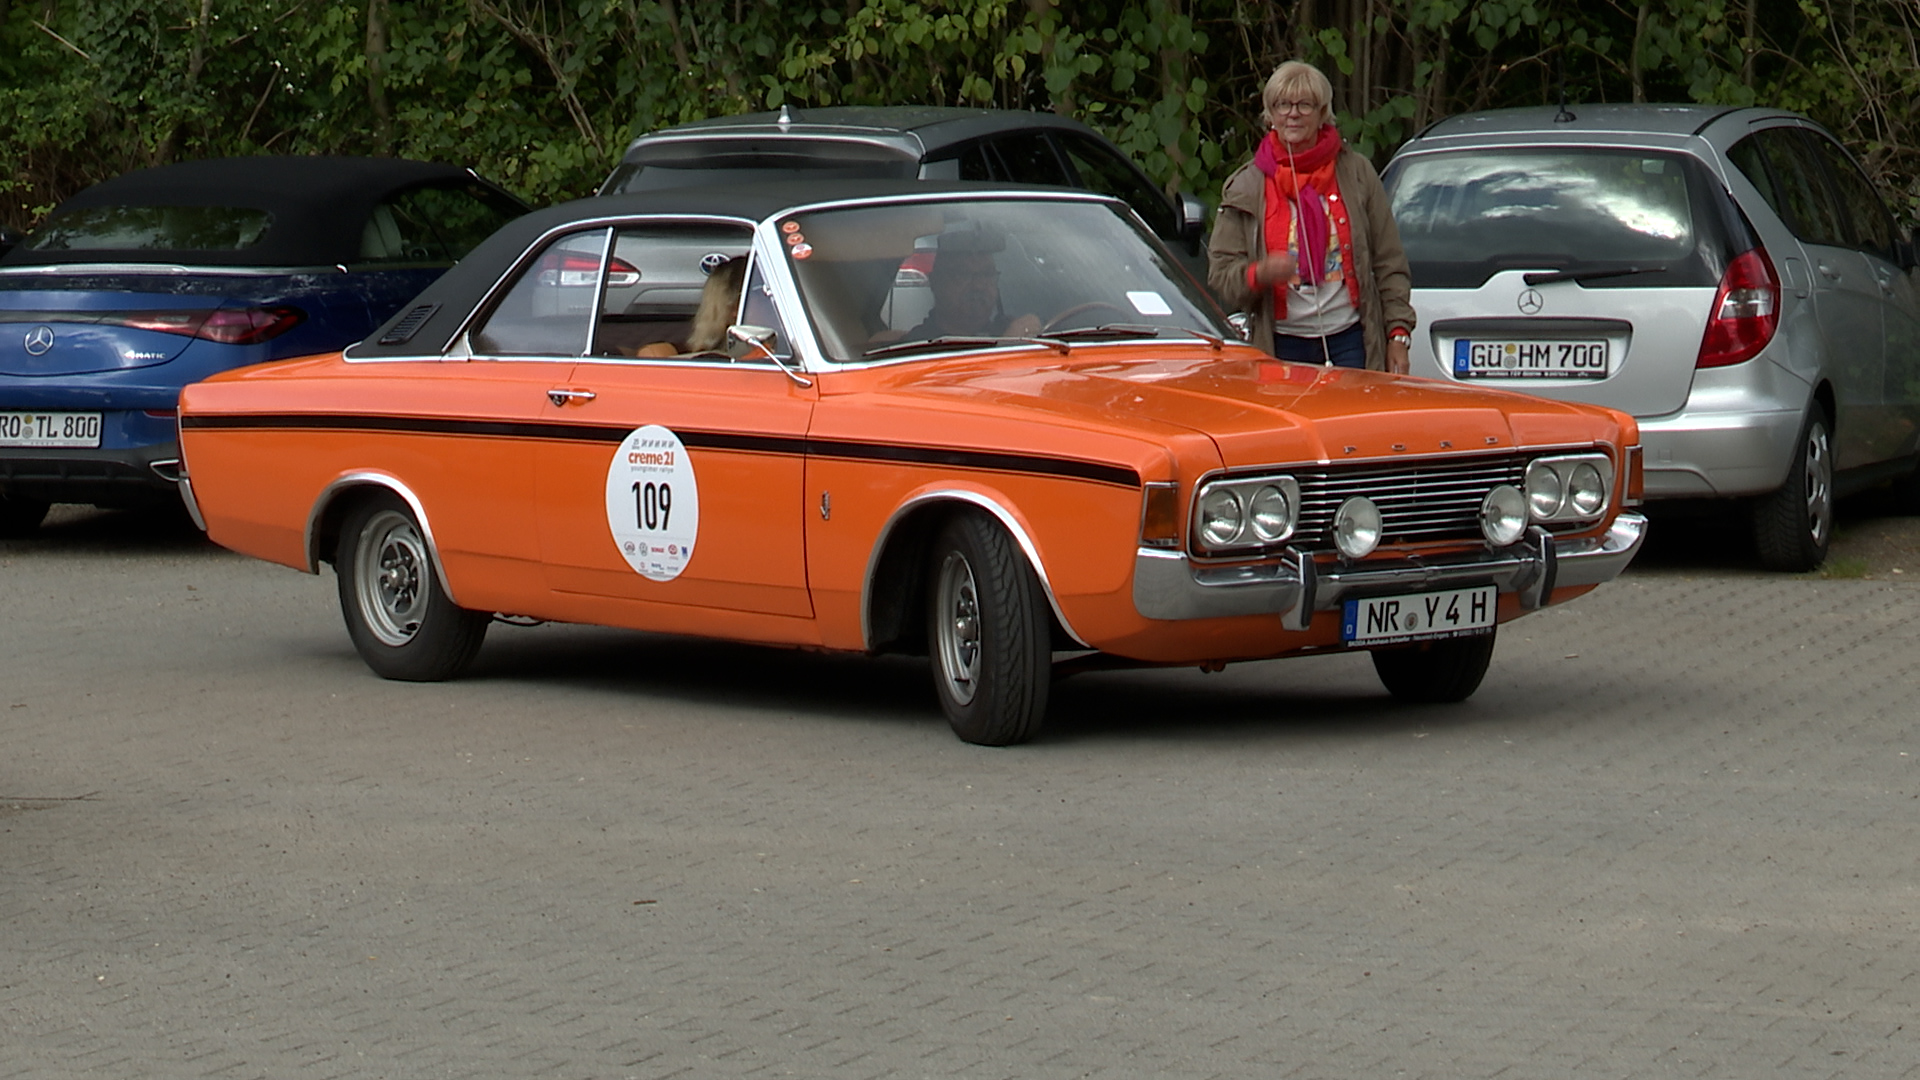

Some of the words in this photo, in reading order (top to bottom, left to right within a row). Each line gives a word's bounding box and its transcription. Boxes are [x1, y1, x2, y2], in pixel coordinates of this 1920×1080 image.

[1471, 344, 1502, 367] GÜ
[1518, 344, 1550, 367] HM
[1558, 344, 1602, 368] 700
[36, 415, 58, 438] TL
[63, 416, 98, 438] 800
[1344, 437, 1498, 455] FORD
[631, 481, 672, 531] 109
[1367, 601, 1400, 634] NR
